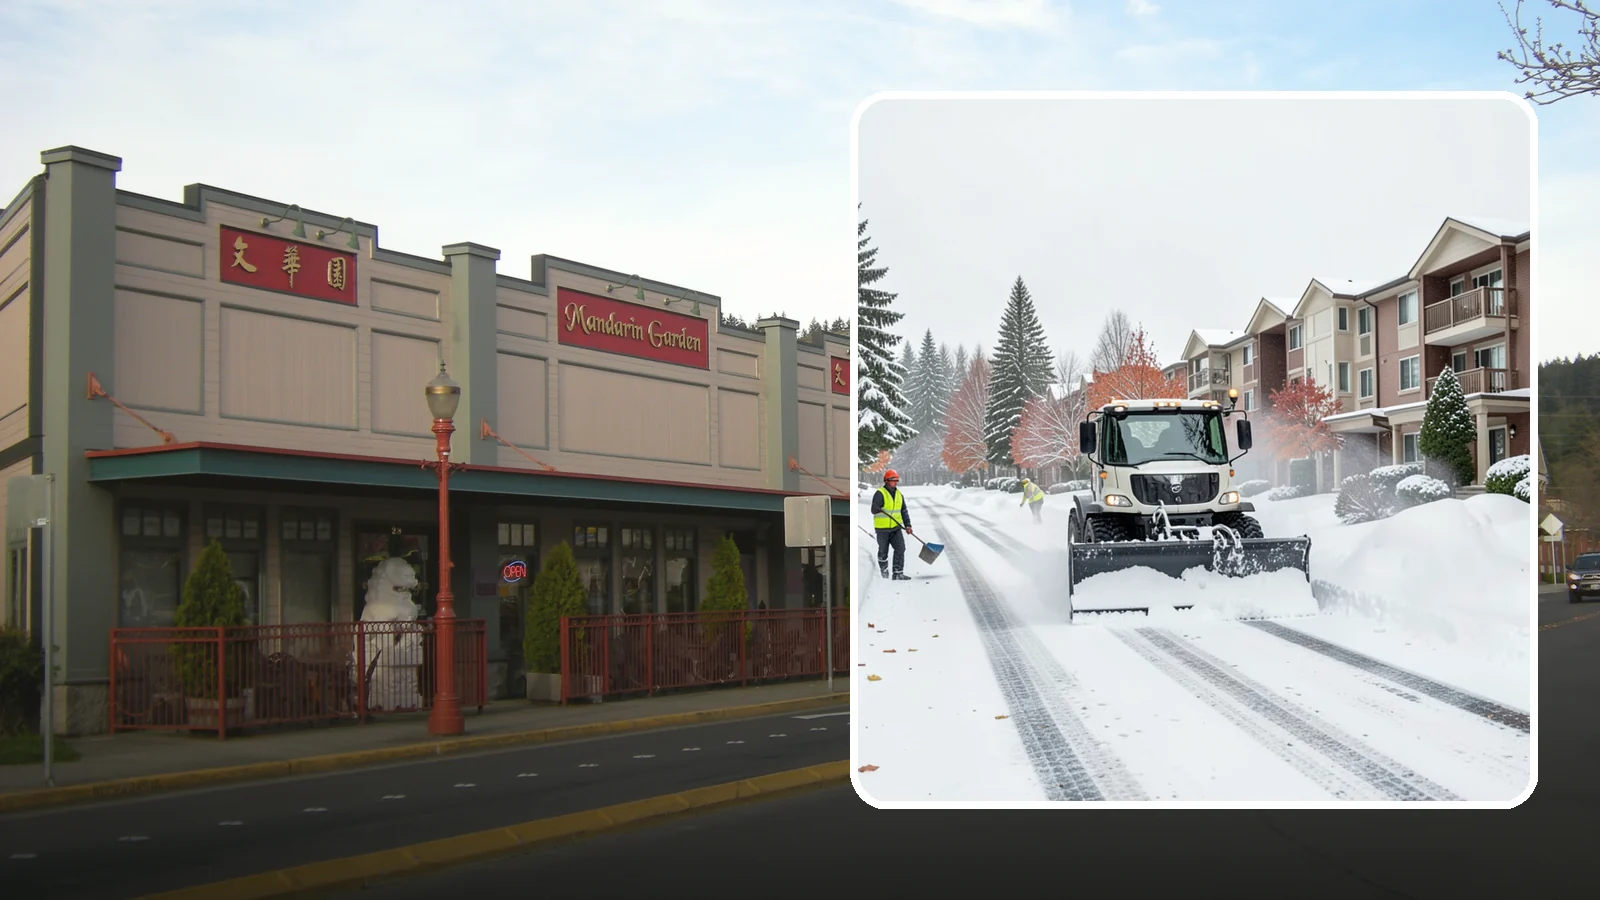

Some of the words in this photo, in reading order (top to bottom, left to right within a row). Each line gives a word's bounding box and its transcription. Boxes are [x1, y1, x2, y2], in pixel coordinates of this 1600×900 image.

[230, 235, 347, 291] 文華園
[564, 301, 644, 341] Mandarin
[647, 320, 701, 352] Garden
[503, 565, 527, 578] OPEN
